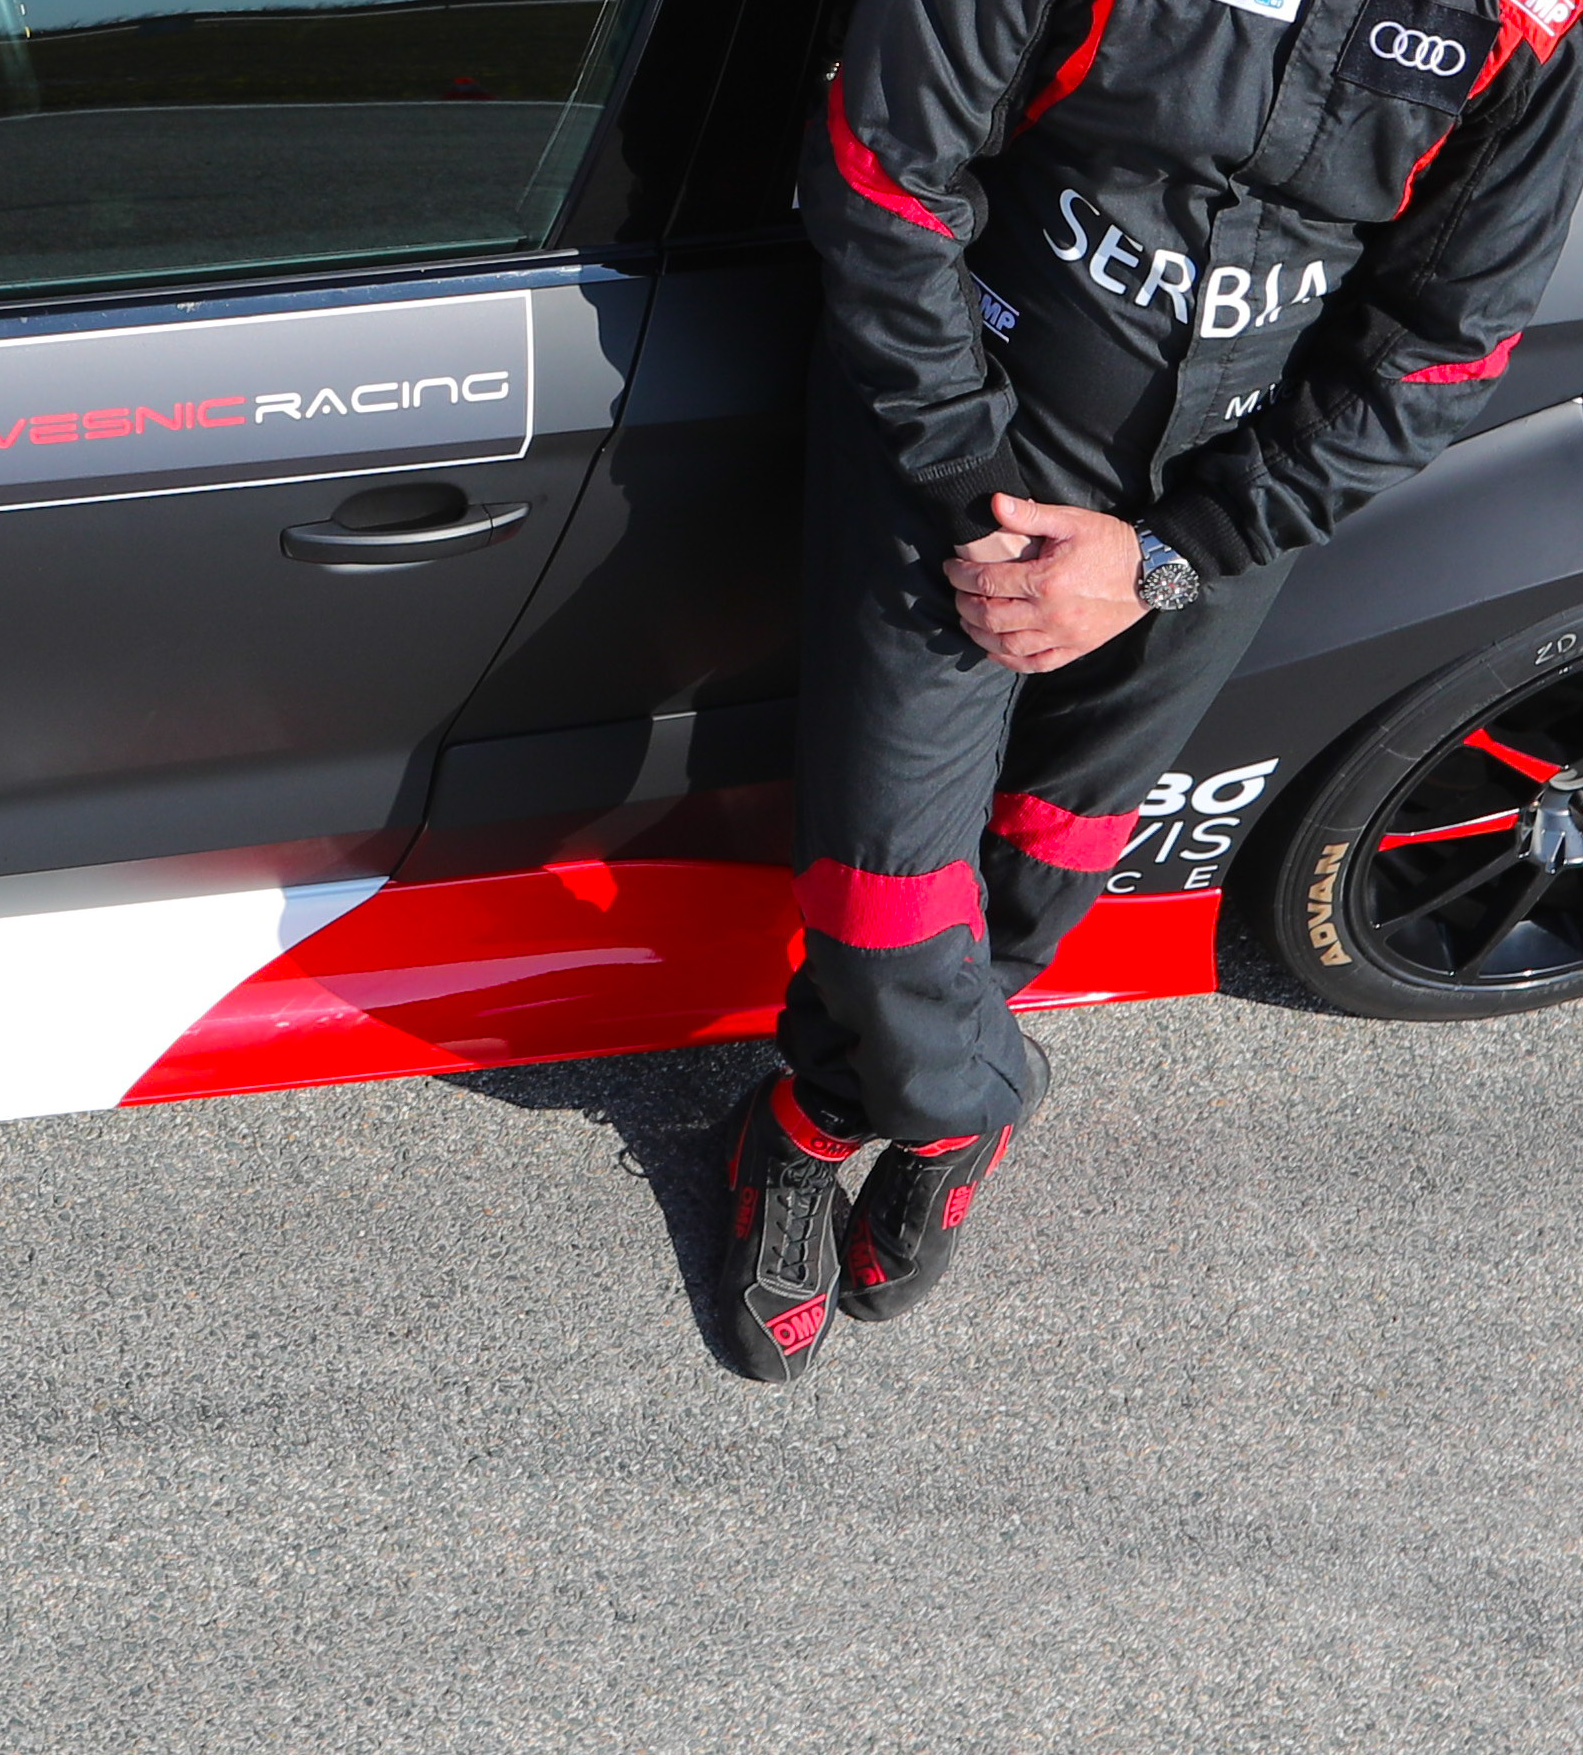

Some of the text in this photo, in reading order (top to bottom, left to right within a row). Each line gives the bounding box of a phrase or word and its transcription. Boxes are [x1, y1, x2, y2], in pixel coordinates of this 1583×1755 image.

[1042, 188, 1328, 340] SERBIA
[976, 282, 1016, 333] MP
[255, 371, 509, 424] RACING
[1307, 842, 1353, 966] ADVAN
[948, 1185, 972, 1226] OMP
[772, 1304, 825, 1345] OMP
